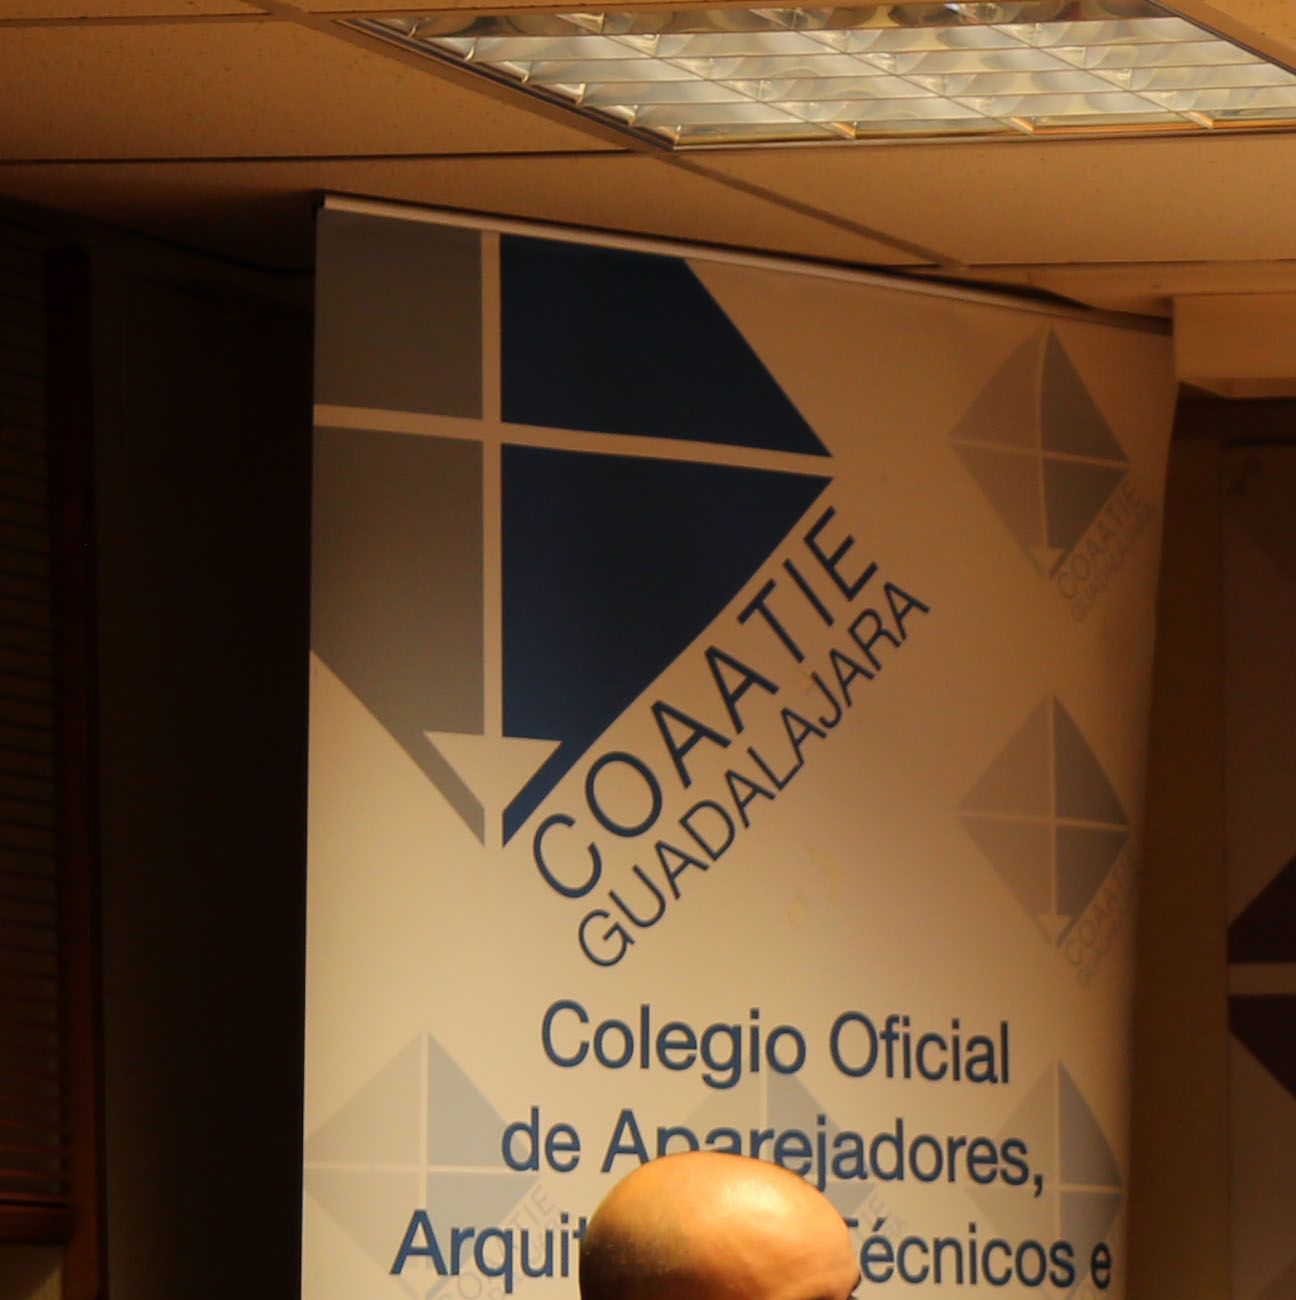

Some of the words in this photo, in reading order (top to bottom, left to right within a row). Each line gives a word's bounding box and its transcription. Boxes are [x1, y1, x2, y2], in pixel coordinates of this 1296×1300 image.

[533, 507, 877, 898] COAATIE
[578, 581, 931, 969] GUADALAJARA
[541, 1000, 806, 1089] Colegio
[829, 1012, 1010, 1085] Oficial
[501, 1108, 581, 1174] de
[846, 1217, 1076, 1288] écnicos
[1090, 1241, 1113, 1290] e
